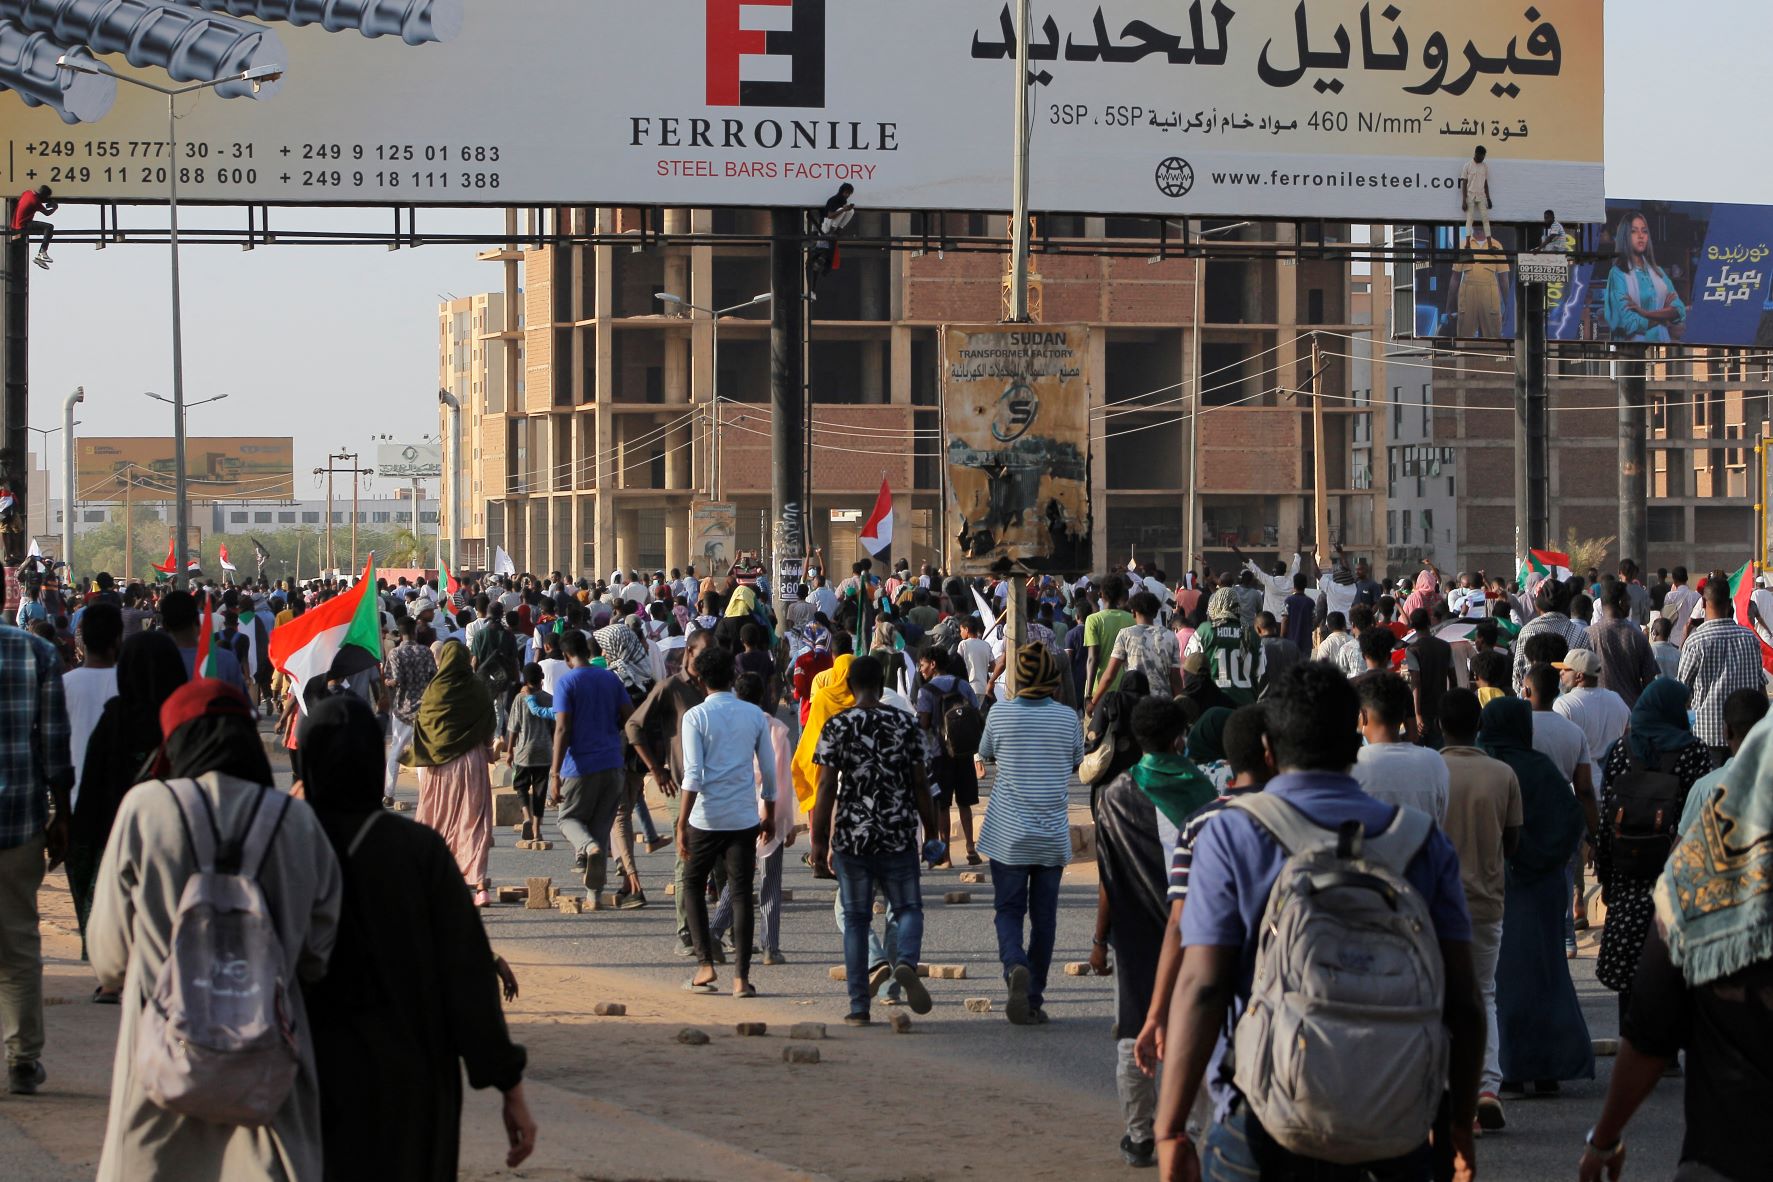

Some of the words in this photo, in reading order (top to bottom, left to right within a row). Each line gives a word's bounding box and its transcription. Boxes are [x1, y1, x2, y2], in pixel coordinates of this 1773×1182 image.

[970, 0, 1236, 87] للحديد
[1257, 0, 1562, 99] فيرونايل
[1049, 104, 1088, 125] 3SP
[1105, 105, 1143, 127] 5SP
[1148, 107, 1217, 134] أوكرانية
[1221, 112, 1255, 134] خام
[1307, 110, 1348, 132] 460
[629, 117, 899, 150] FERRONILE
[1259, 115, 1298, 136] مواد
[1439, 118, 1485, 136] الشد
[1491, 119, 1529, 141] قوة
[25, 140, 75, 157] +249
[84, 140, 120, 157] 155
[185, 142, 209, 158] 30
[232, 142, 253, 159] 31
[302, 143, 341, 160] 249
[352, 144, 364, 160] 9
[375, 144, 414, 161] 125
[425, 145, 447, 161] 01
[461, 145, 500, 162] 683
[50, 166, 91, 183] 249
[104, 166, 127, 183] 11
[141, 167, 167, 184] 20
[179, 167, 205, 184] 88
[217, 167, 257, 185] 600
[302, 170, 341, 187] 249
[352, 170, 364, 187] 9
[375, 171, 400, 187] 18
[412, 171, 447, 188] 111
[461, 172, 500, 189] 388
[656, 160, 719, 177] STEEL
[725, 161, 778, 178] BARS
[784, 162, 877, 180] FACTORY
[1010, 331, 1067, 346] SUDAN
[1214, 647, 1253, 689] 10
